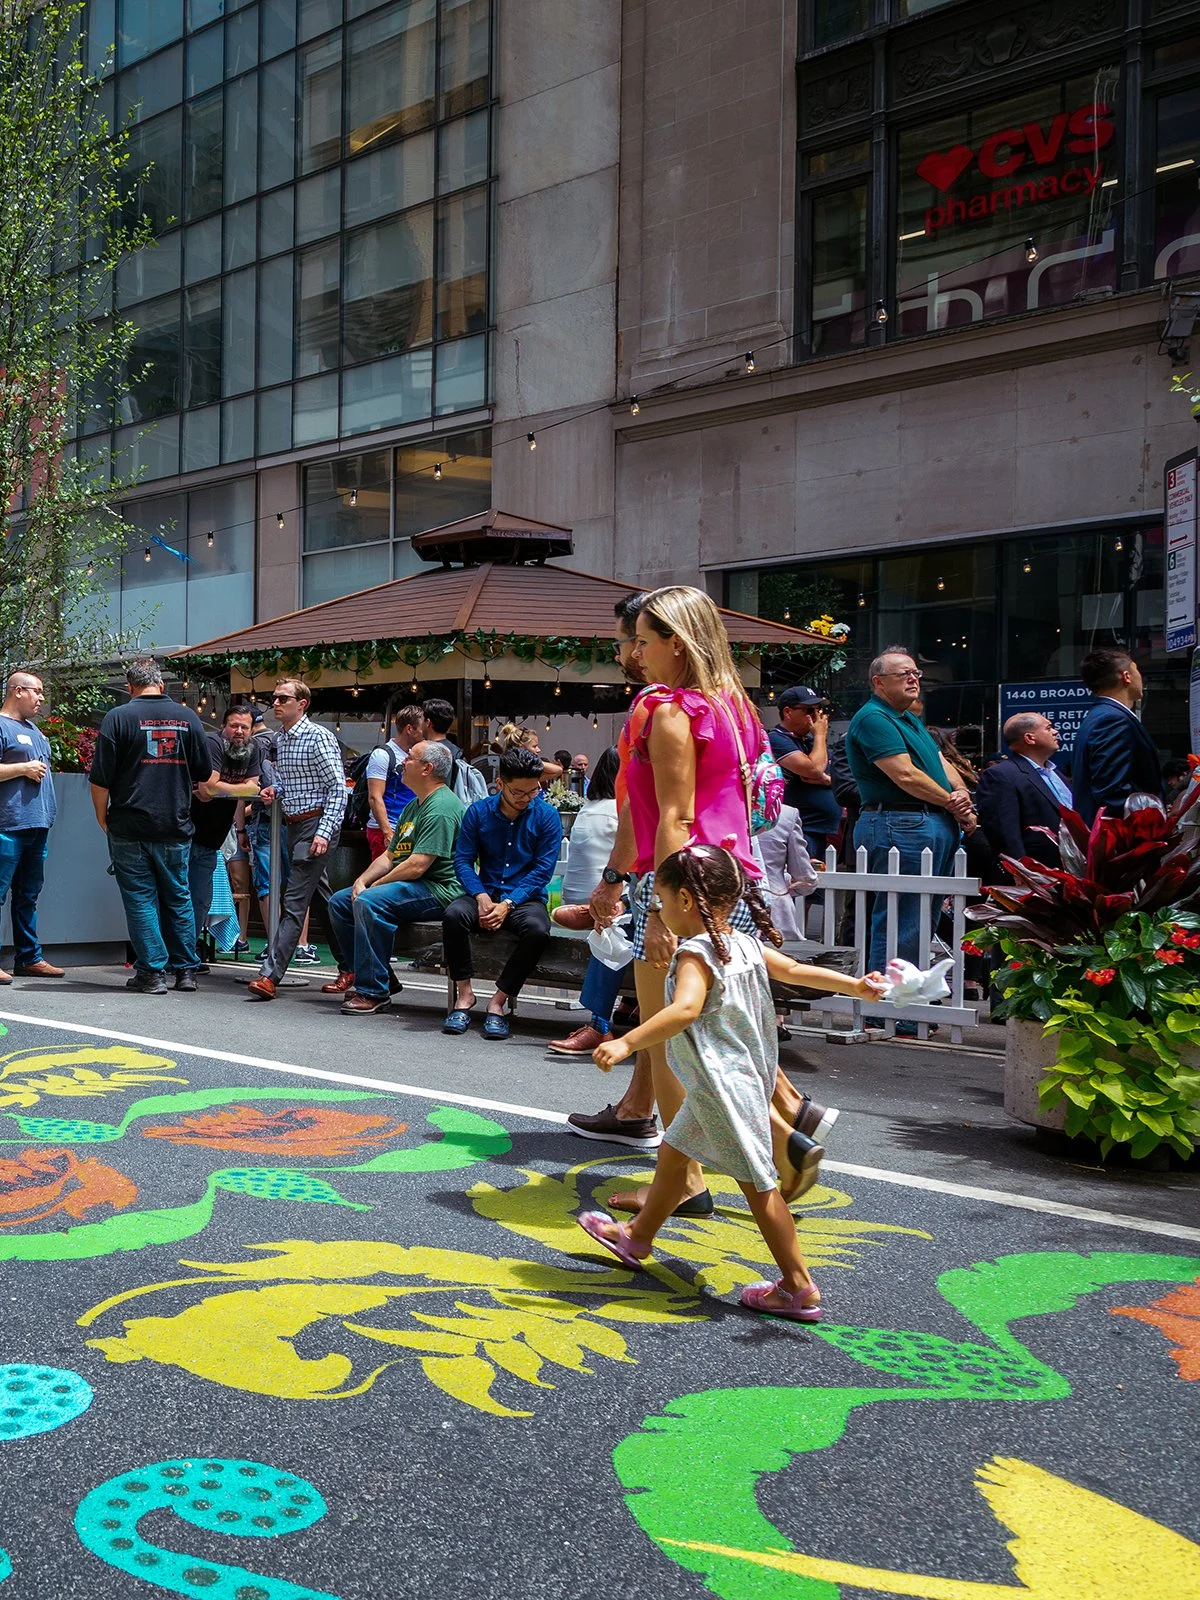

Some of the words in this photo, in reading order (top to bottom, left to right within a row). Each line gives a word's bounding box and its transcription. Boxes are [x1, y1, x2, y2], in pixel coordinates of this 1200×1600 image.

[978, 102, 1114, 178] CVS
[924, 163, 1104, 237] pharmacy
[1169, 472, 1175, 488] 3
[1169, 553, 1175, 569] 6
[1006, 690, 1036, 699] 1440
[140, 719, 190, 727] UPRIGHT
